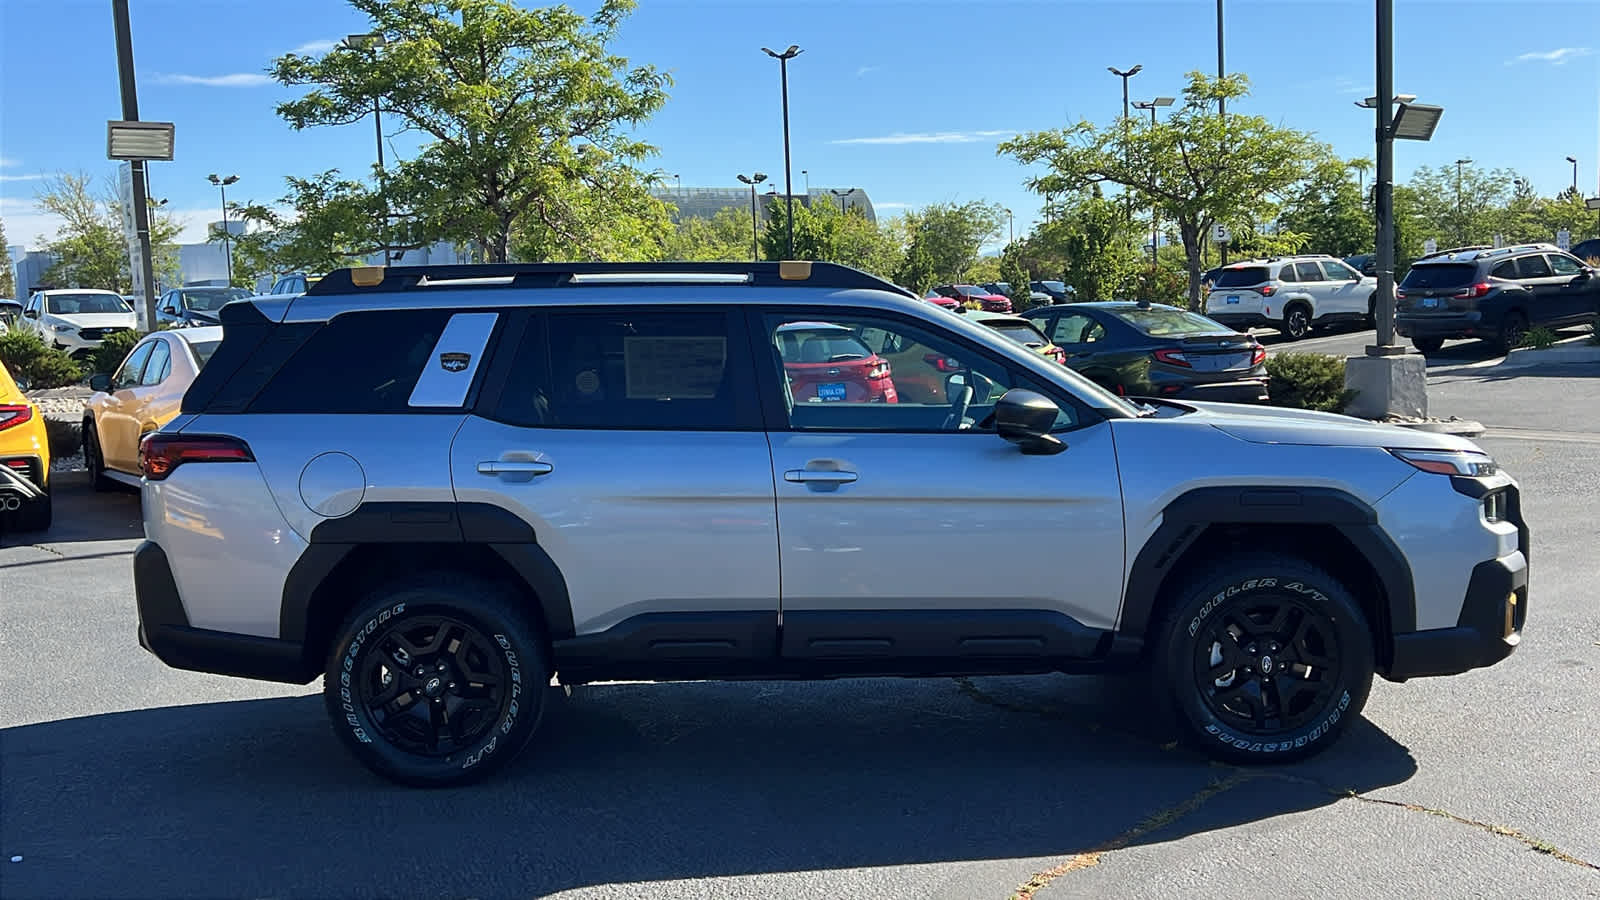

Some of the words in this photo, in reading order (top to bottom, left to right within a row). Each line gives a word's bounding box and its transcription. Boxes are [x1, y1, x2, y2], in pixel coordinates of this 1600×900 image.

[1217, 225, 1226, 238] 5
[1187, 577, 1278, 637] DUELER
[1284, 582, 1329, 601] A/T
[340, 602, 406, 743] BRIDGESTONE
[494, 633, 521, 734] DUELER
[1205, 690, 1351, 752] BRIDGESTONE
[462, 736, 497, 769] A/T
